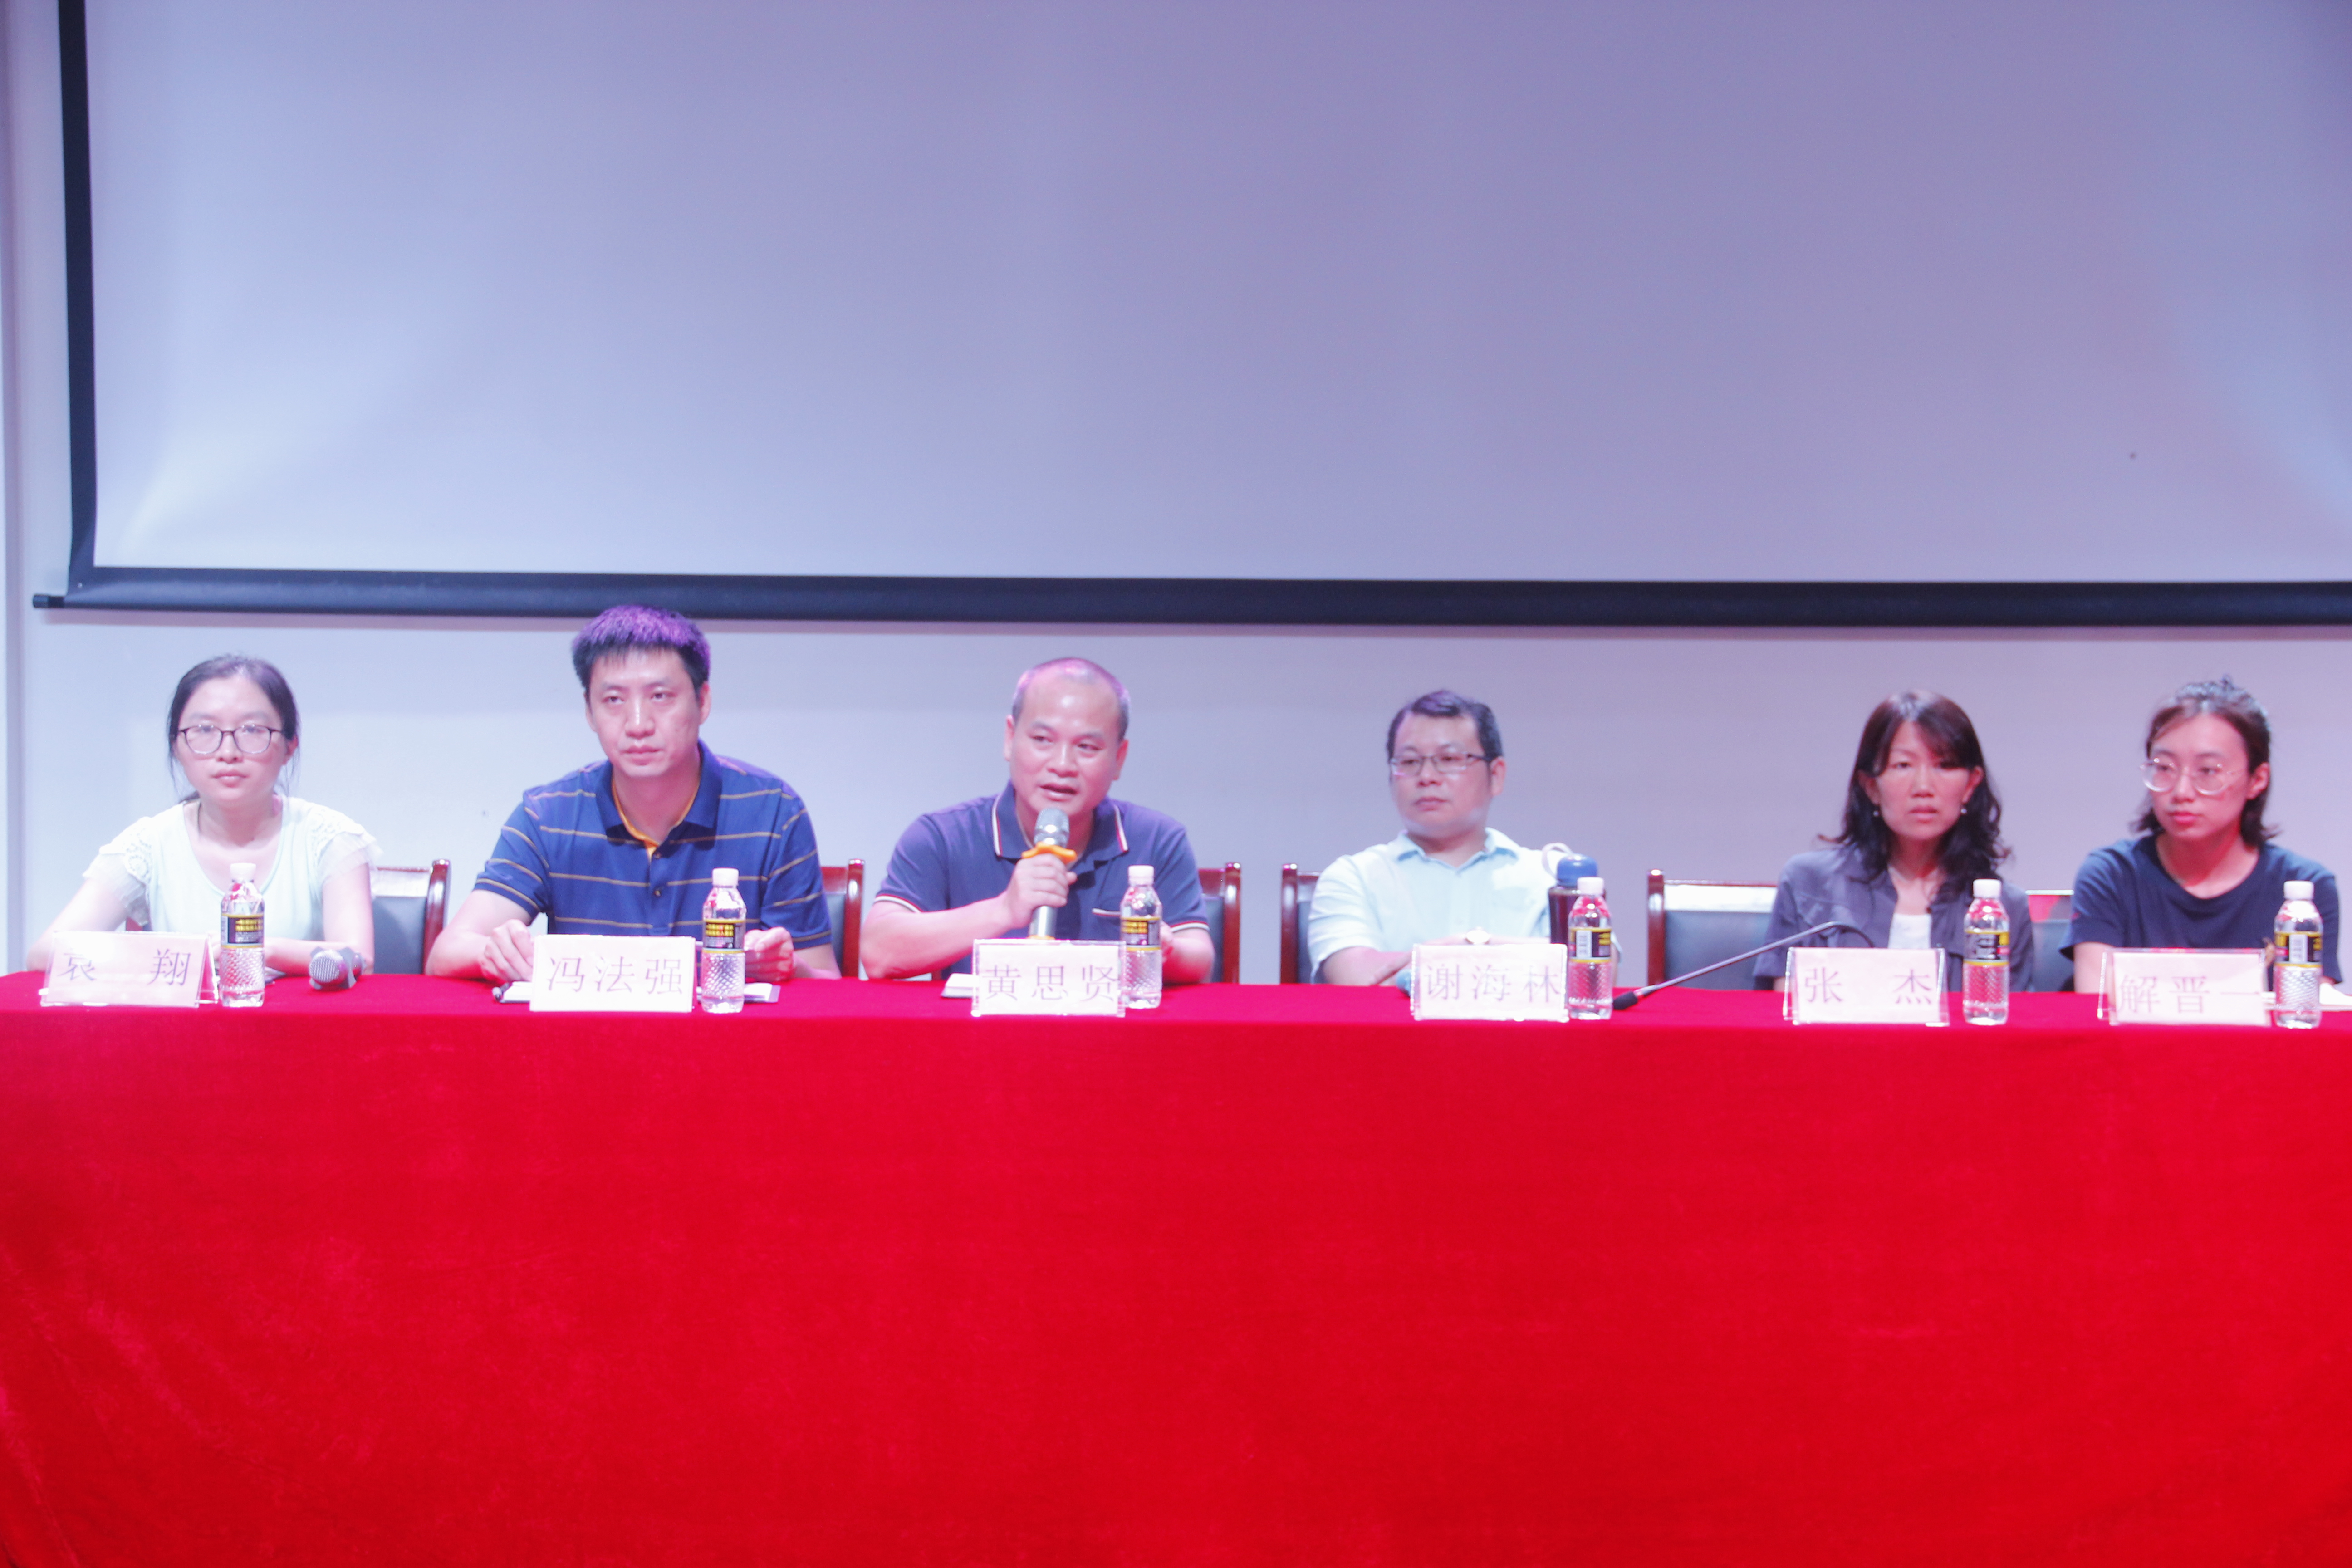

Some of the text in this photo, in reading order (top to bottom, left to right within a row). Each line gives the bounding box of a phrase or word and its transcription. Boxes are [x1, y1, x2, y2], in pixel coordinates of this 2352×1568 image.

[147, 948, 191, 986] 翔
[547, 955, 682, 995] 冯法强
[981, 964, 1120, 1002] 黄思贤
[1424, 963, 1561, 1003] 谢海林
[1804, 966, 1933, 1005] 张 杰
[2117, 975, 2260, 1014] 解晋一
